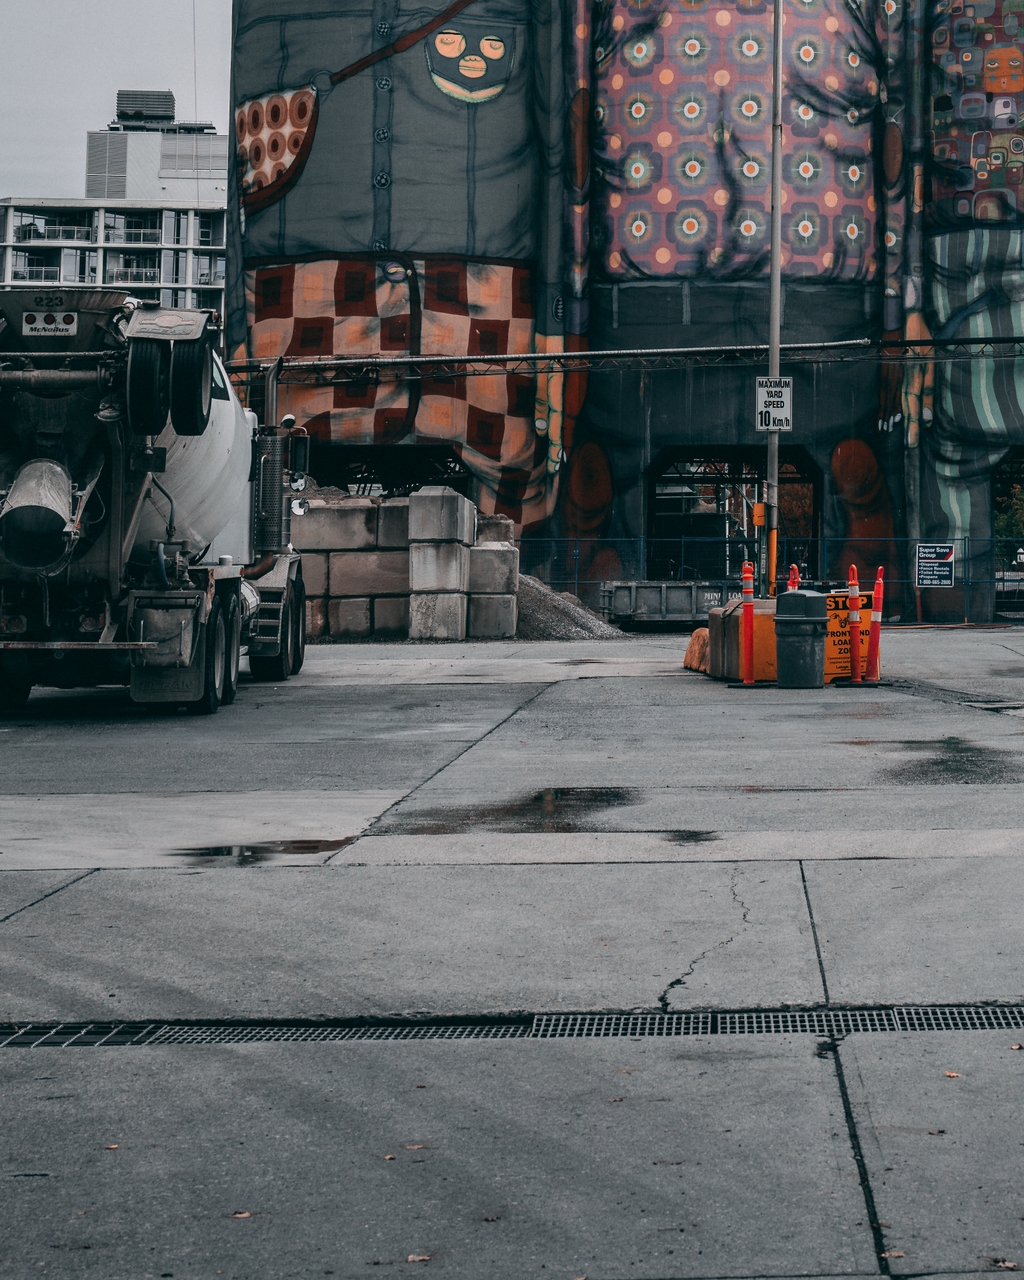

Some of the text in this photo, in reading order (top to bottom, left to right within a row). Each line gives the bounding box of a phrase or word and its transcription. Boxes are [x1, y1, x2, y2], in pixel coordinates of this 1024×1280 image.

[34, 296, 64, 307] 223
[758, 380, 790, 388] MAXIMUM
[766, 390, 783, 398] YARD
[758, 410, 790, 427] 10 Km/h
